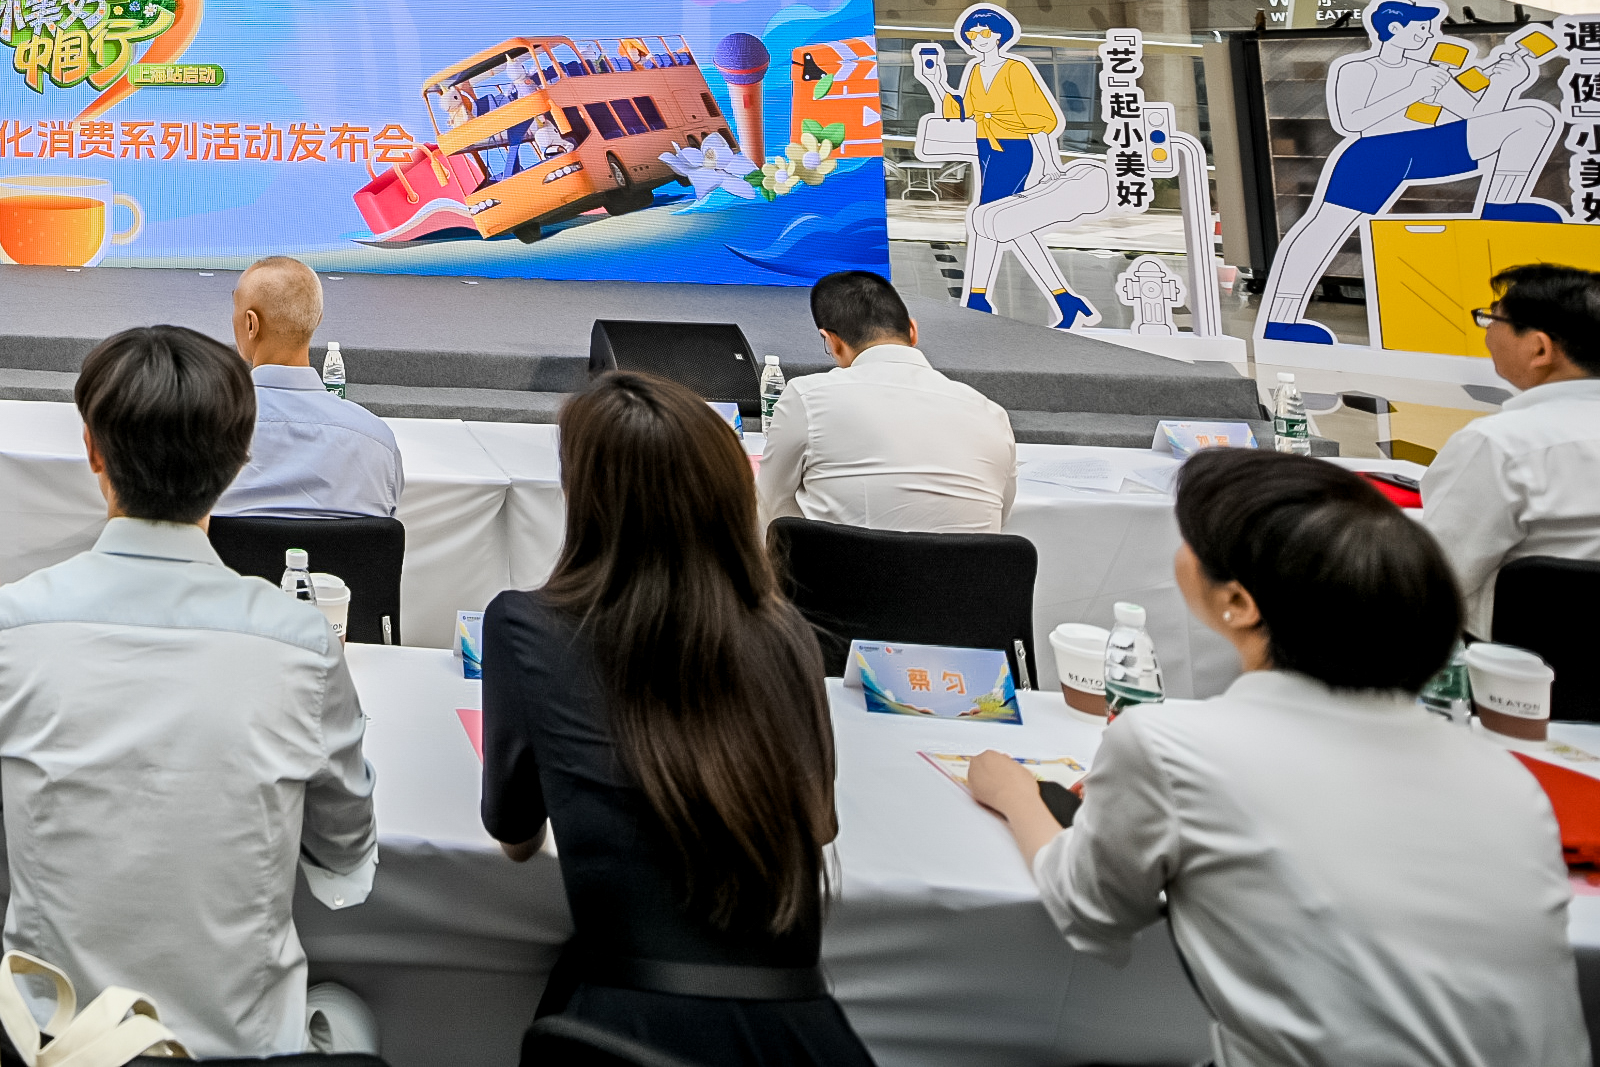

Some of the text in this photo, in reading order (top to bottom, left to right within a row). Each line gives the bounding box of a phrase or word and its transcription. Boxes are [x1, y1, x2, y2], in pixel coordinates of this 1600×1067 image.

[14, 8, 175, 94] 中国行
[134, 66, 216, 83] 上海站启动
[1068, 672, 1104, 687] BEATO
